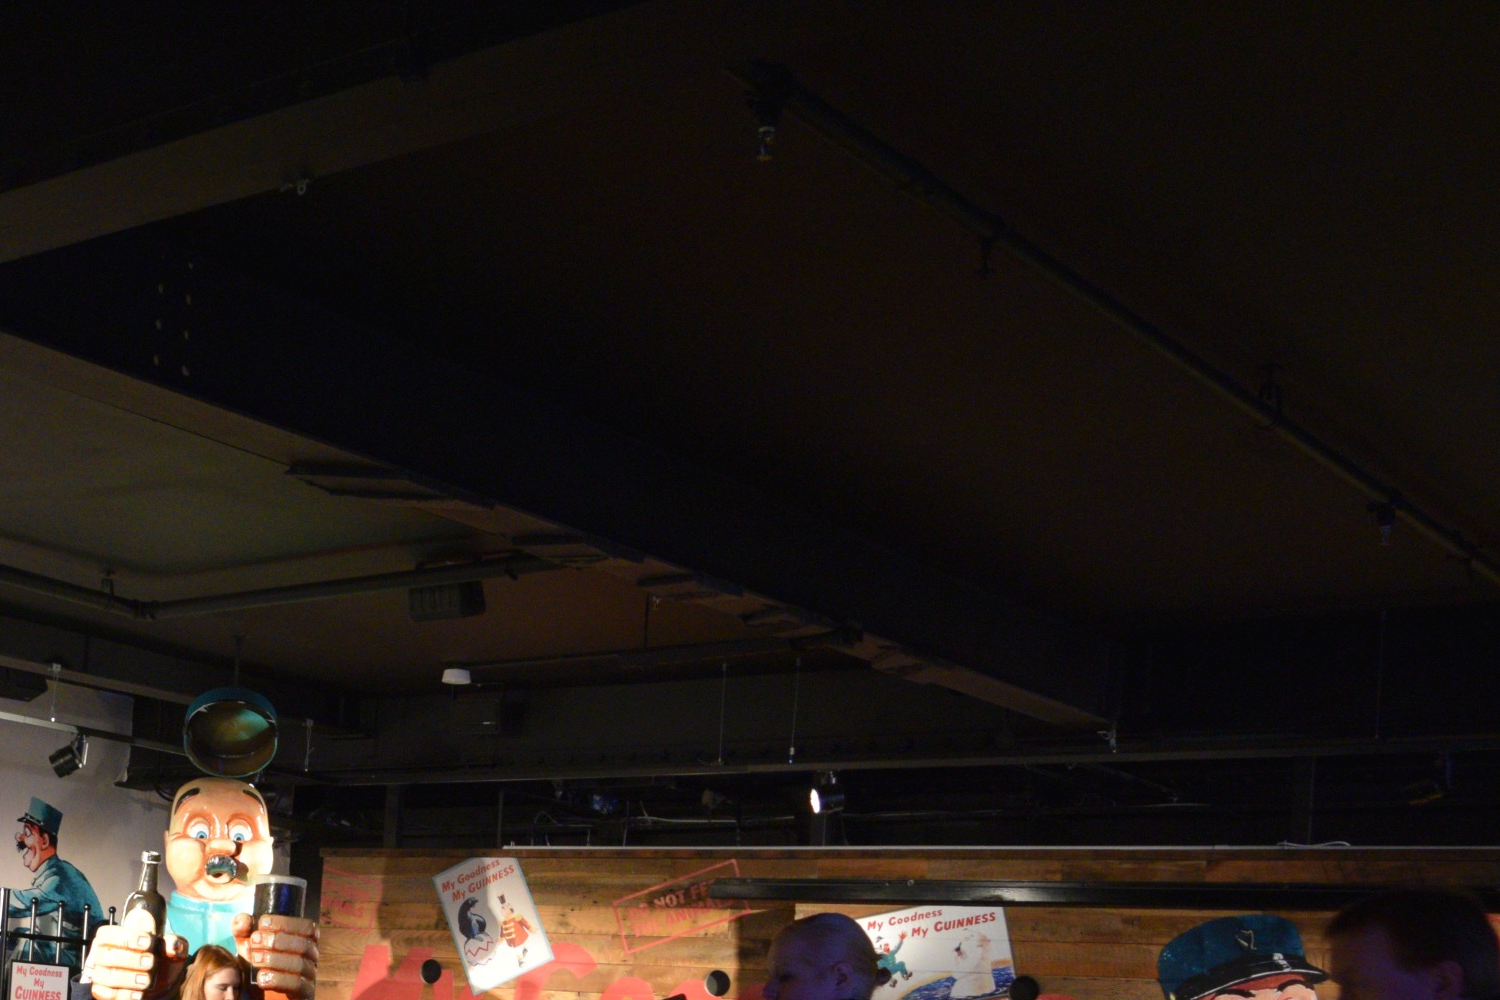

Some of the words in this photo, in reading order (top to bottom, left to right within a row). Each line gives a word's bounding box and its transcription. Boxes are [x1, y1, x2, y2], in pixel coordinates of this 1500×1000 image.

[442, 880, 455, 893] My
[457, 859, 500, 884] Goodness
[452, 890, 466, 902] My
[468, 864, 515, 893] GUINNESS
[653, 889, 686, 909] NOT
[689, 878, 716, 899] FE
[867, 921, 884, 931] My
[888, 909, 943, 927] Goodness
[911, 926, 929, 938] My
[934, 912, 996, 933] GUINNESS
[16, 965, 27, 977] My
[29, 966, 63, 978] Goodness
[33, 978, 45, 989] My
